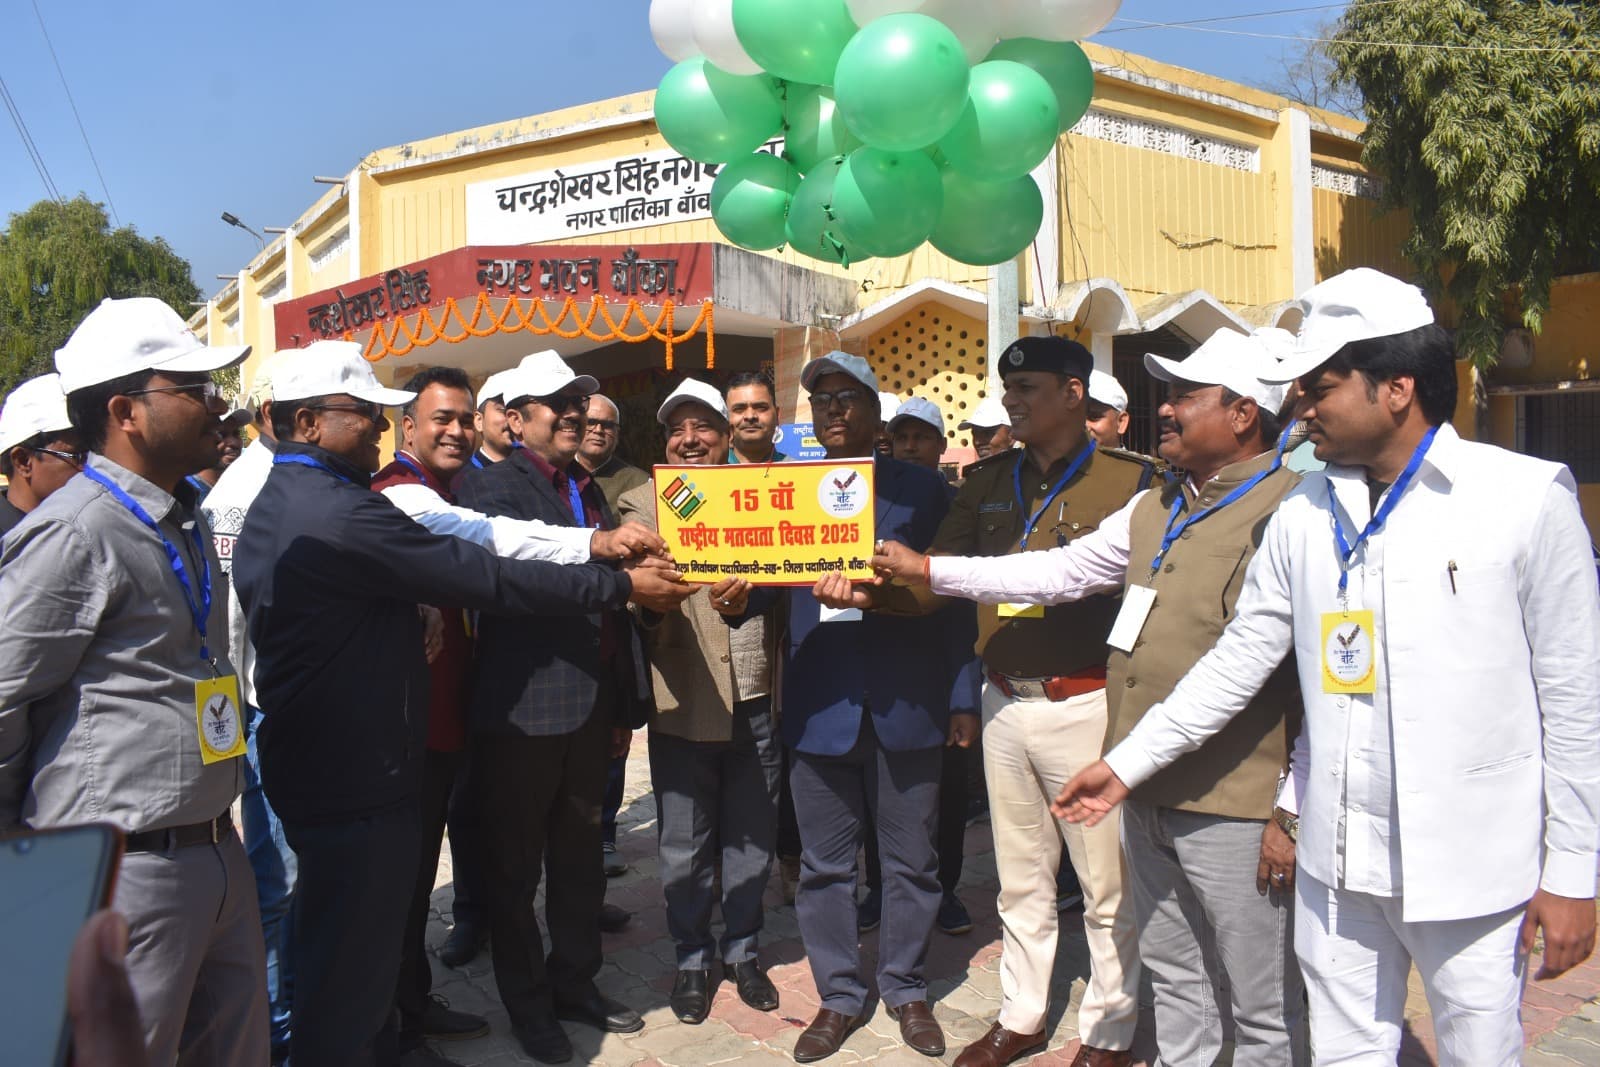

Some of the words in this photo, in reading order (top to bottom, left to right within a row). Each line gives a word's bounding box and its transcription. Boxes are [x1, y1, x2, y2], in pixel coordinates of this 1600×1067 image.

[495, 169, 613, 214] चन्द्रशेखर
[615, 158, 660, 195] सिंह
[566, 208, 607, 230] नगर
[609, 197, 672, 224] पालिका
[677, 186, 711, 214] बाँक
[477, 259, 533, 293] नगर
[538, 257, 600, 293] भवन
[730, 489, 759, 512] 15
[677, 522, 719, 551] राष्ट्रीय
[723, 526, 774, 547] मतदाता
[778, 520, 815, 546] दिवस
[821, 523, 859, 544] 2025
[783, 559, 804, 574] जिला
